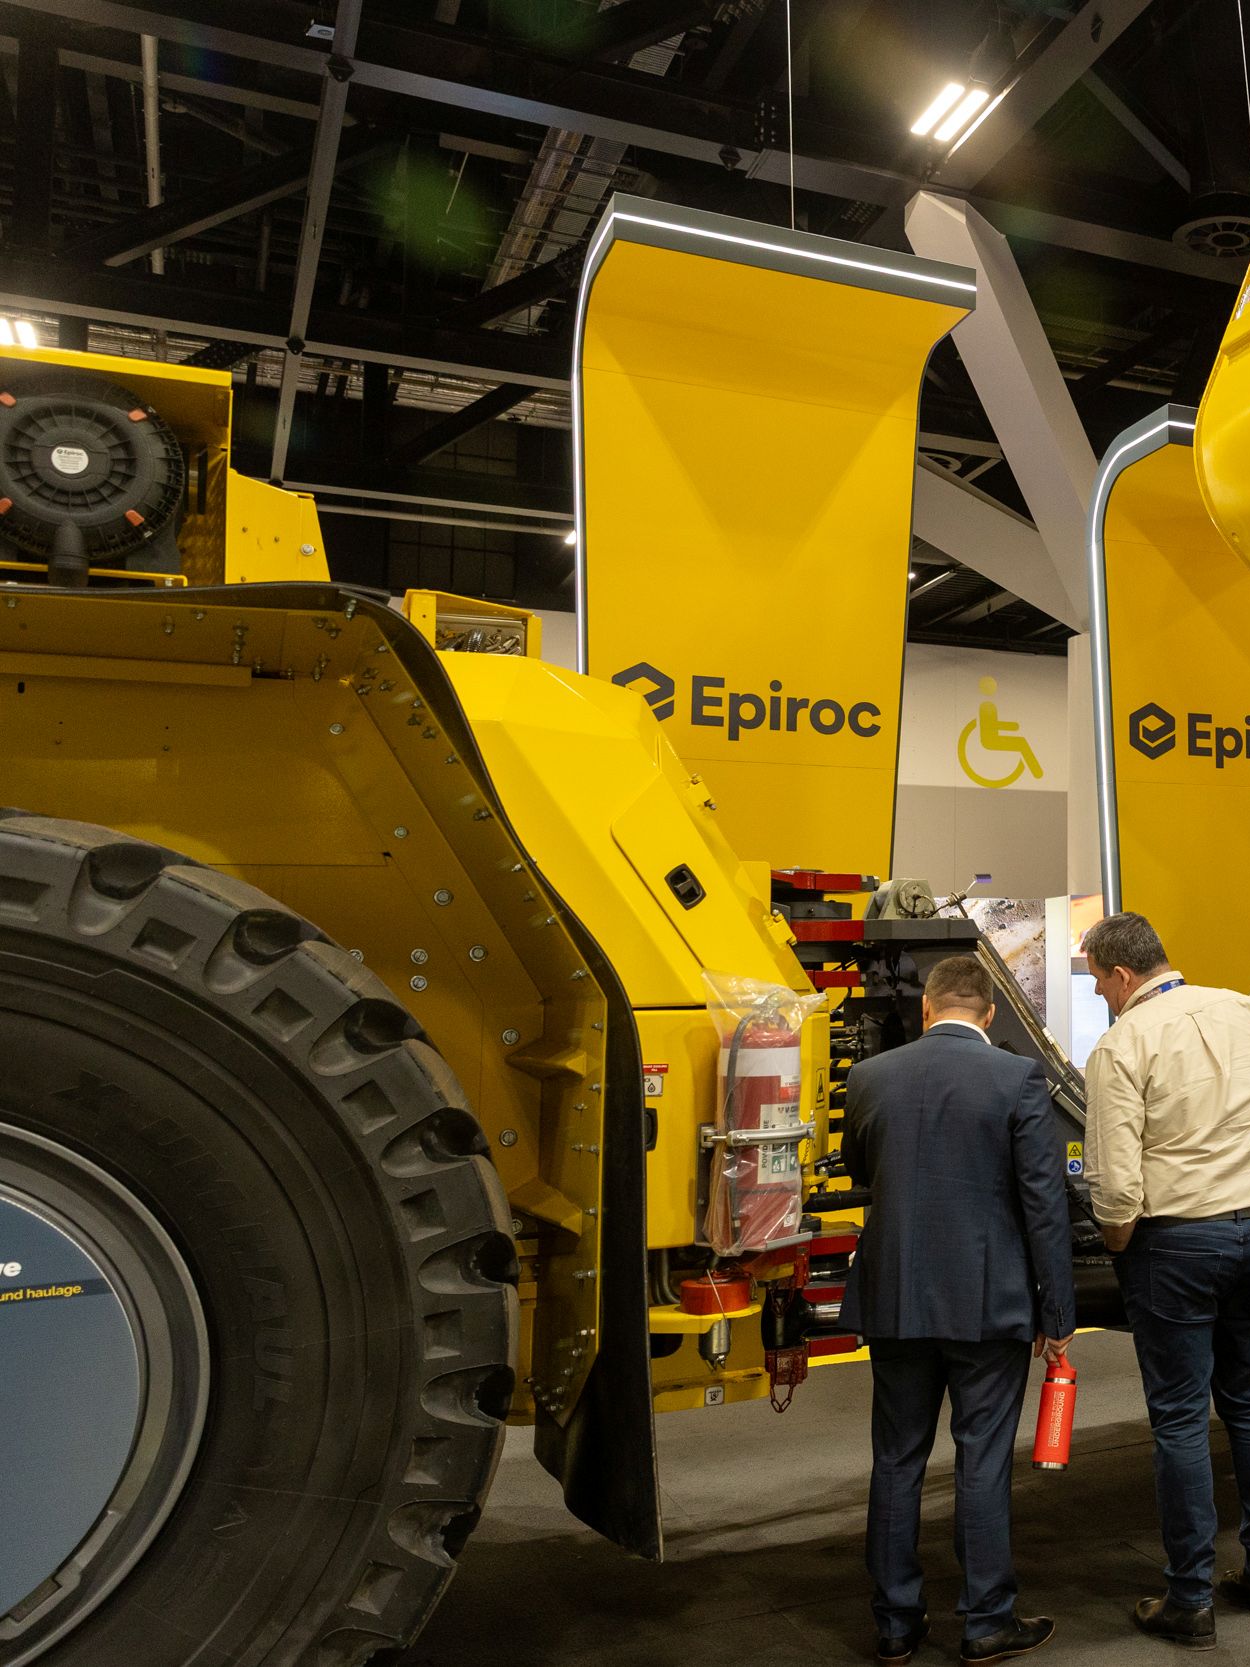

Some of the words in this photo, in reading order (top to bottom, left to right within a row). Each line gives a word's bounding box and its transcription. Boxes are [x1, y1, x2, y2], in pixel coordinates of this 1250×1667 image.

[690, 674, 882, 742] Epiroc
[26, 1284, 85, 1299] haulage.
[1053, 1391, 1065, 1448] UNDERGROUND
